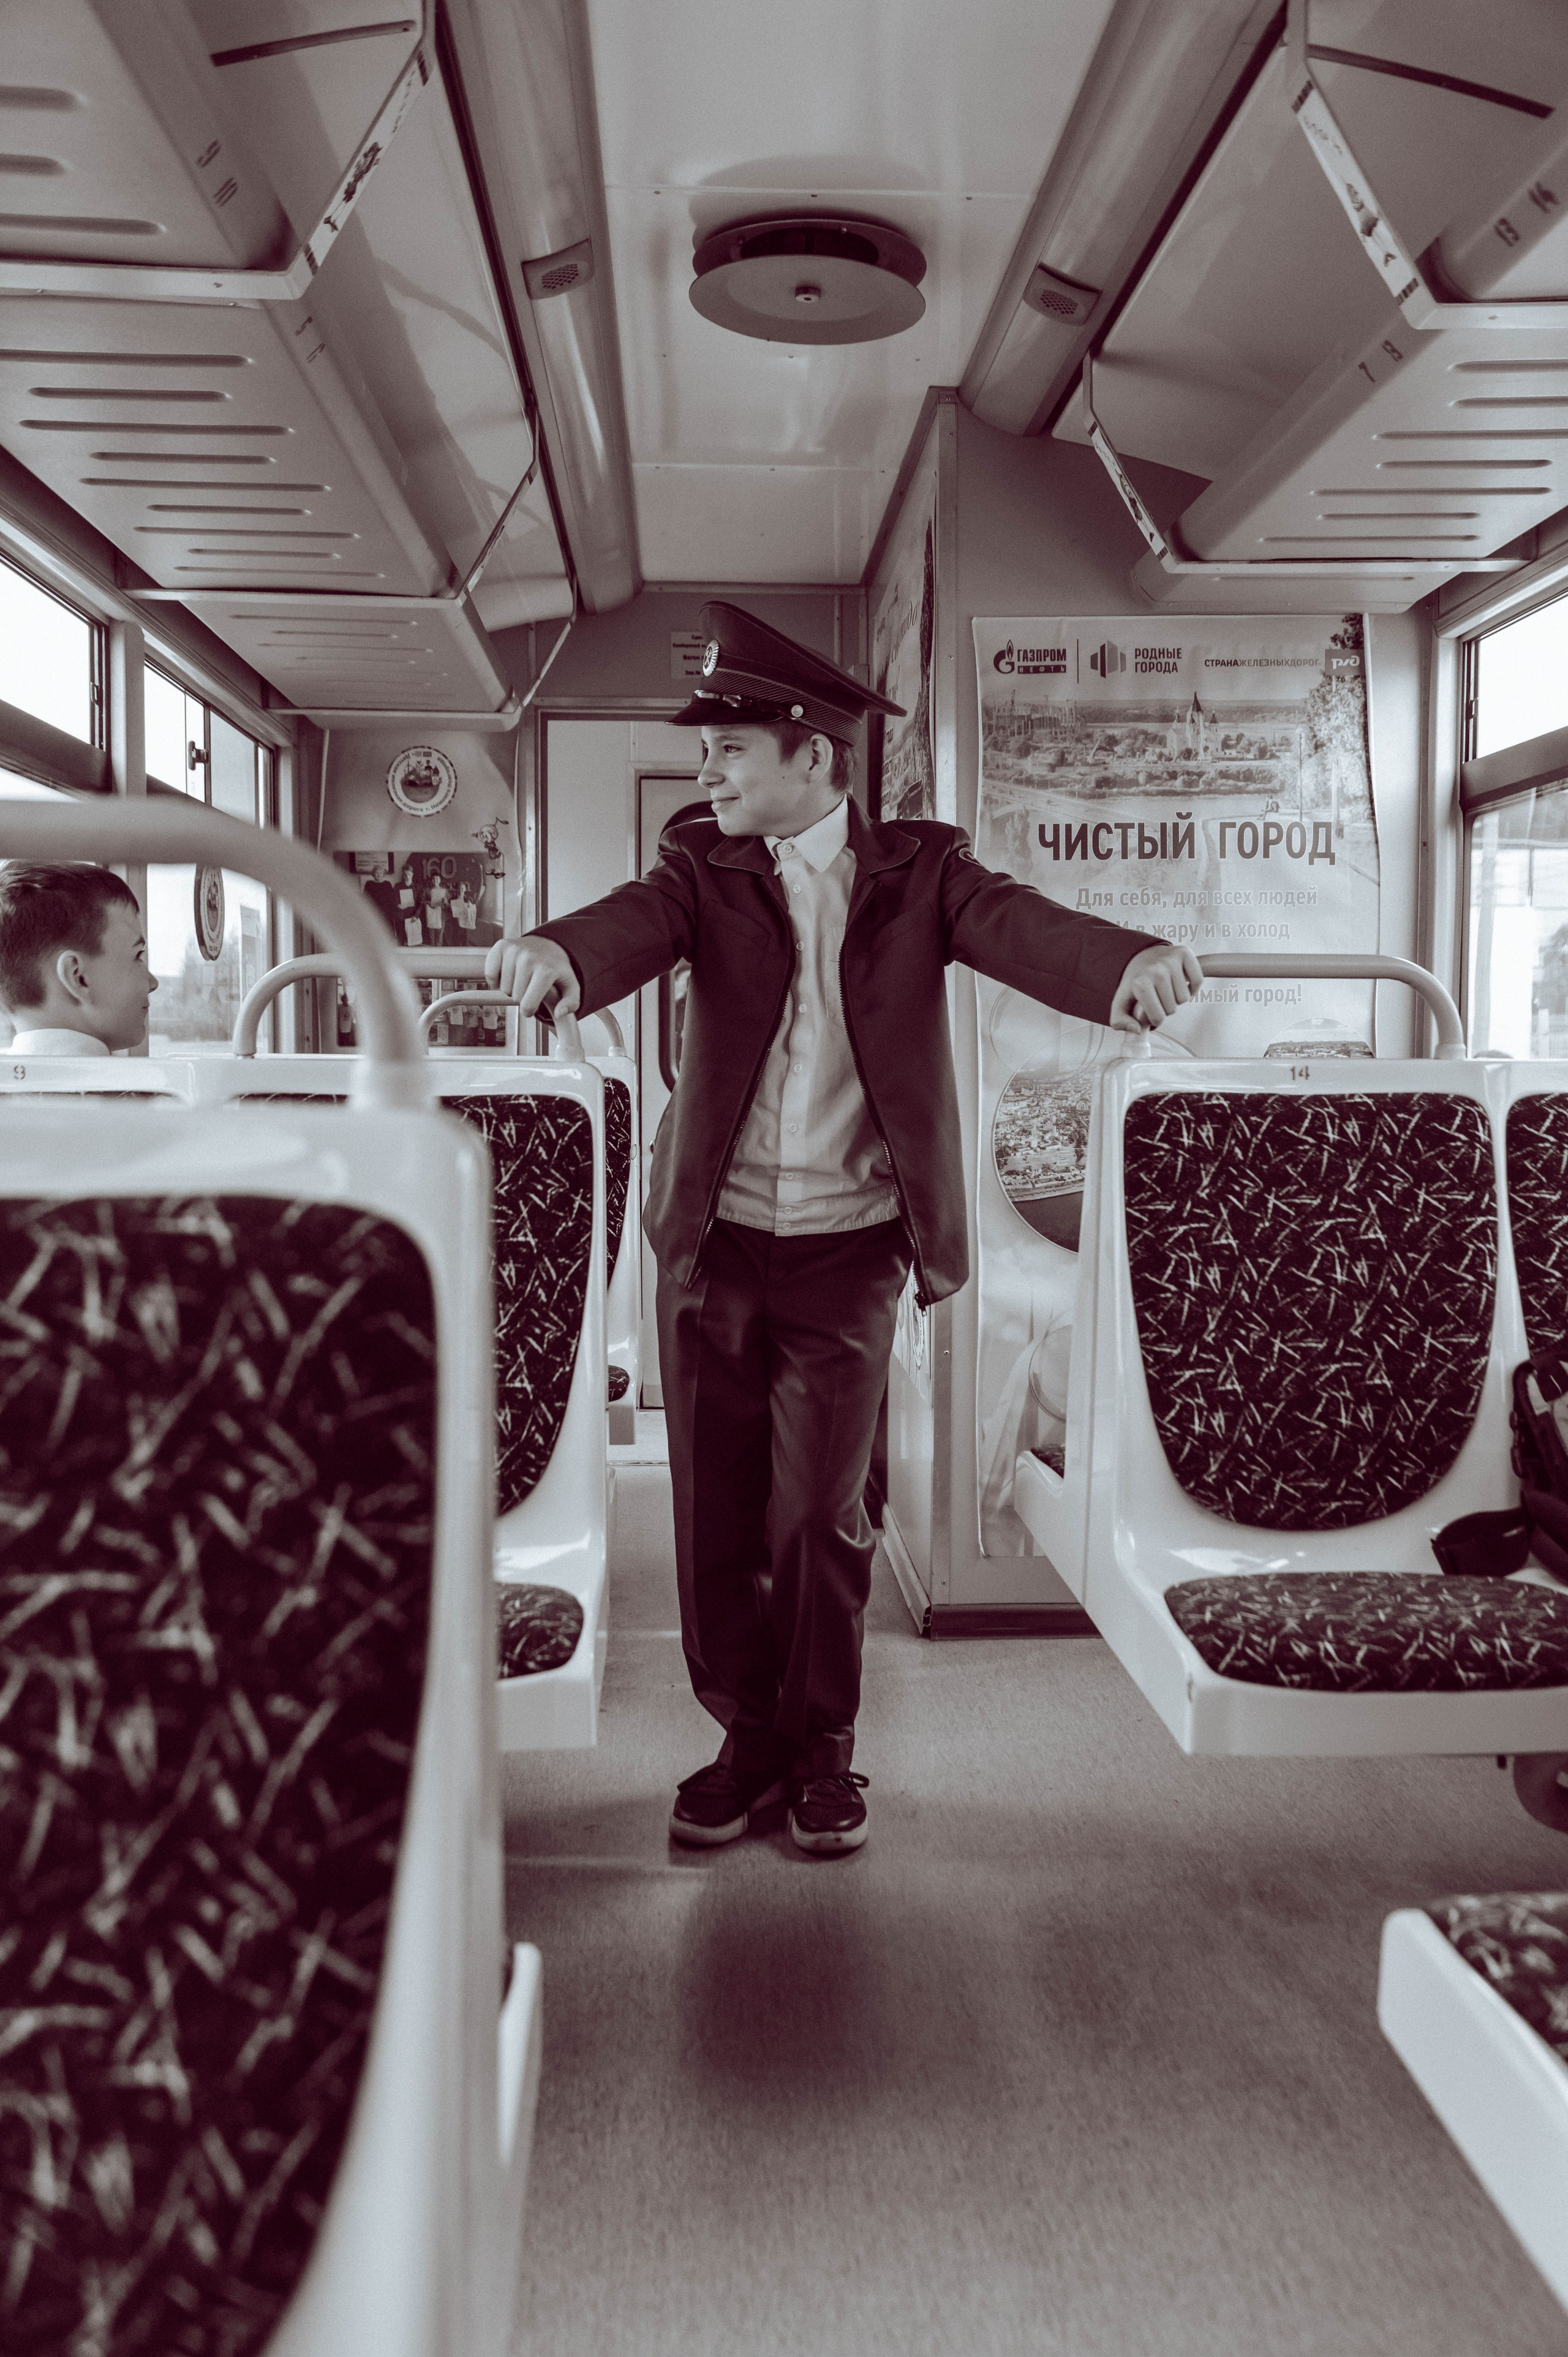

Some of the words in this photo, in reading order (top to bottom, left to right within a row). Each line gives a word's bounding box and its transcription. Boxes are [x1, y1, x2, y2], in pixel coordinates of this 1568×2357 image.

[1382, 339, 1404, 363] 8
[1017, 649, 1067, 662] ГАЗПРОМ
[1134, 647, 1183, 661] РОДНЫЕ
[1019, 665, 1066, 673] НЕФТЬ
[1134, 661, 1178, 674] ГОРОДА
[1038, 812, 1195, 861] ЧИСТЫЙ
[1219, 821, 1336, 865] ГОРОД
[1076, 888, 1114, 910] Для
[1120, 886, 1167, 908] себя,
[1173, 891, 1208, 908] для
[1214, 891, 1253, 905] всех
[1257, 886, 1317, 908] людей
[1152, 924, 1199, 943] жару
[1204, 924, 1215, 938] и
[1221, 924, 1231, 938] в
[1237, 924, 1291, 940] холод
[1188, 984, 1239, 1003] имый
[1245, 983, 1302, 1007] город!
[13, 1065, 26, 1080] 9
[1290, 1066, 1310, 1080] 14
